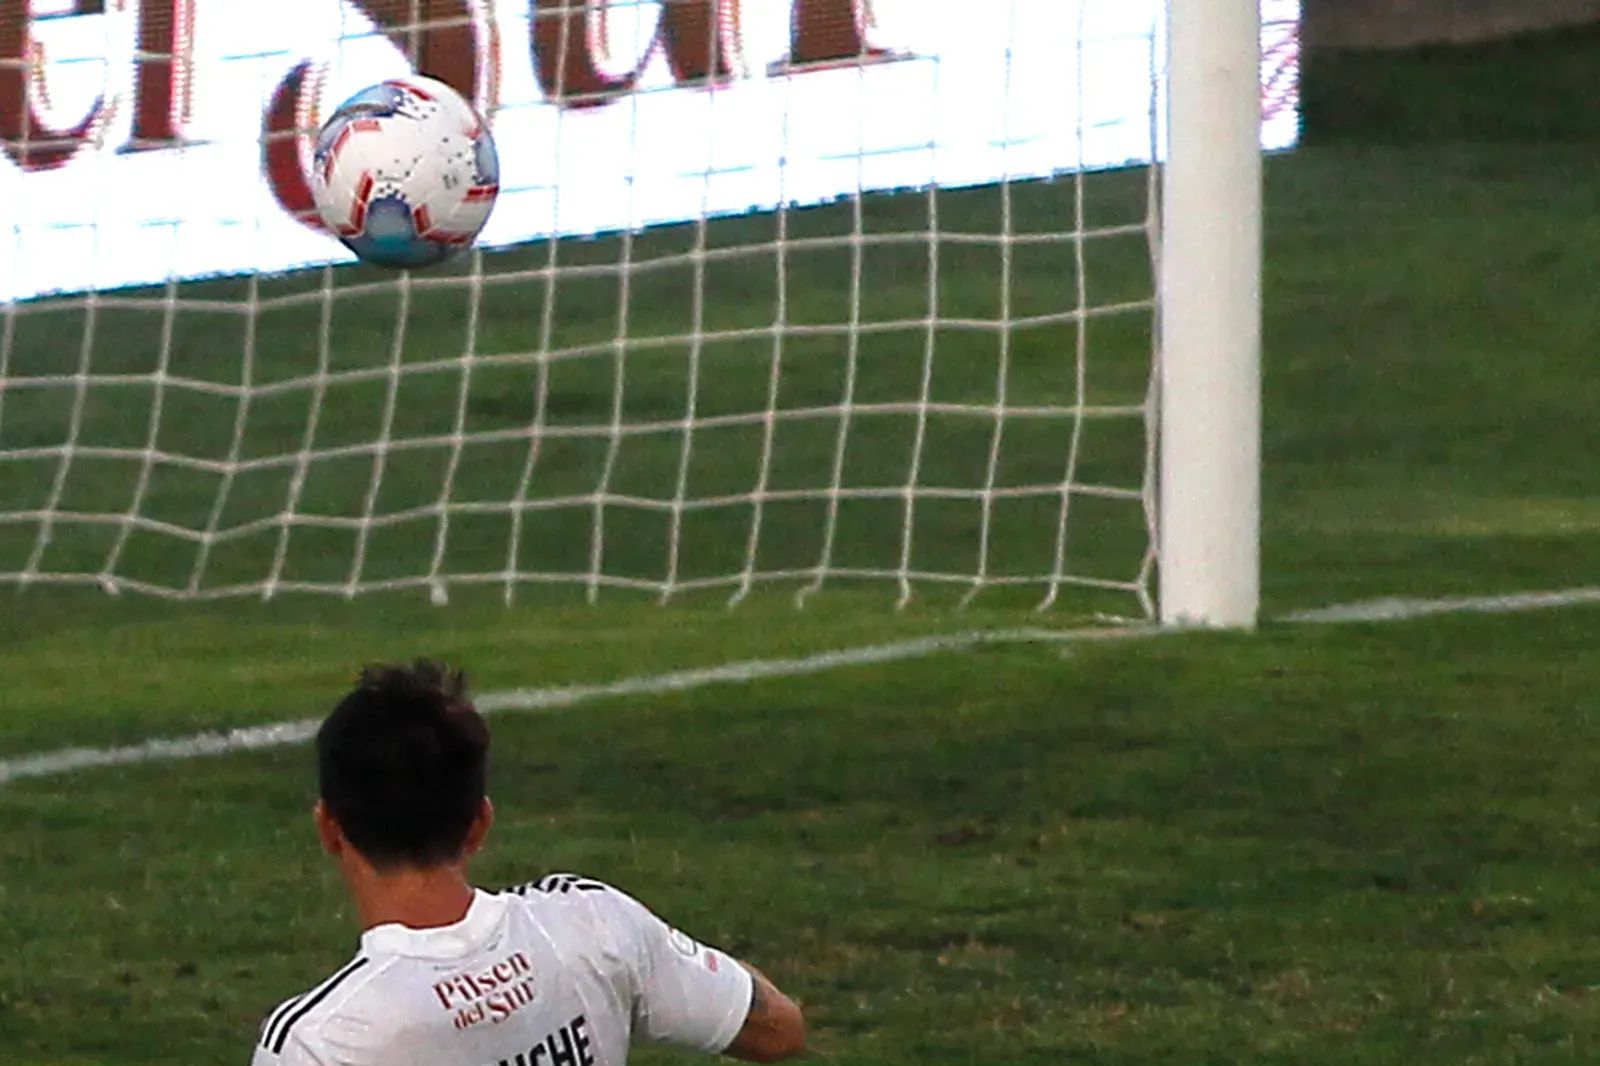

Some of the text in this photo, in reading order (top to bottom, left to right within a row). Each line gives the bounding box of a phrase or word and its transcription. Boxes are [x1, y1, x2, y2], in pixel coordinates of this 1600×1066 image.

[432, 952, 531, 1010] Pilsen
[453, 977, 534, 1030] del Sur
